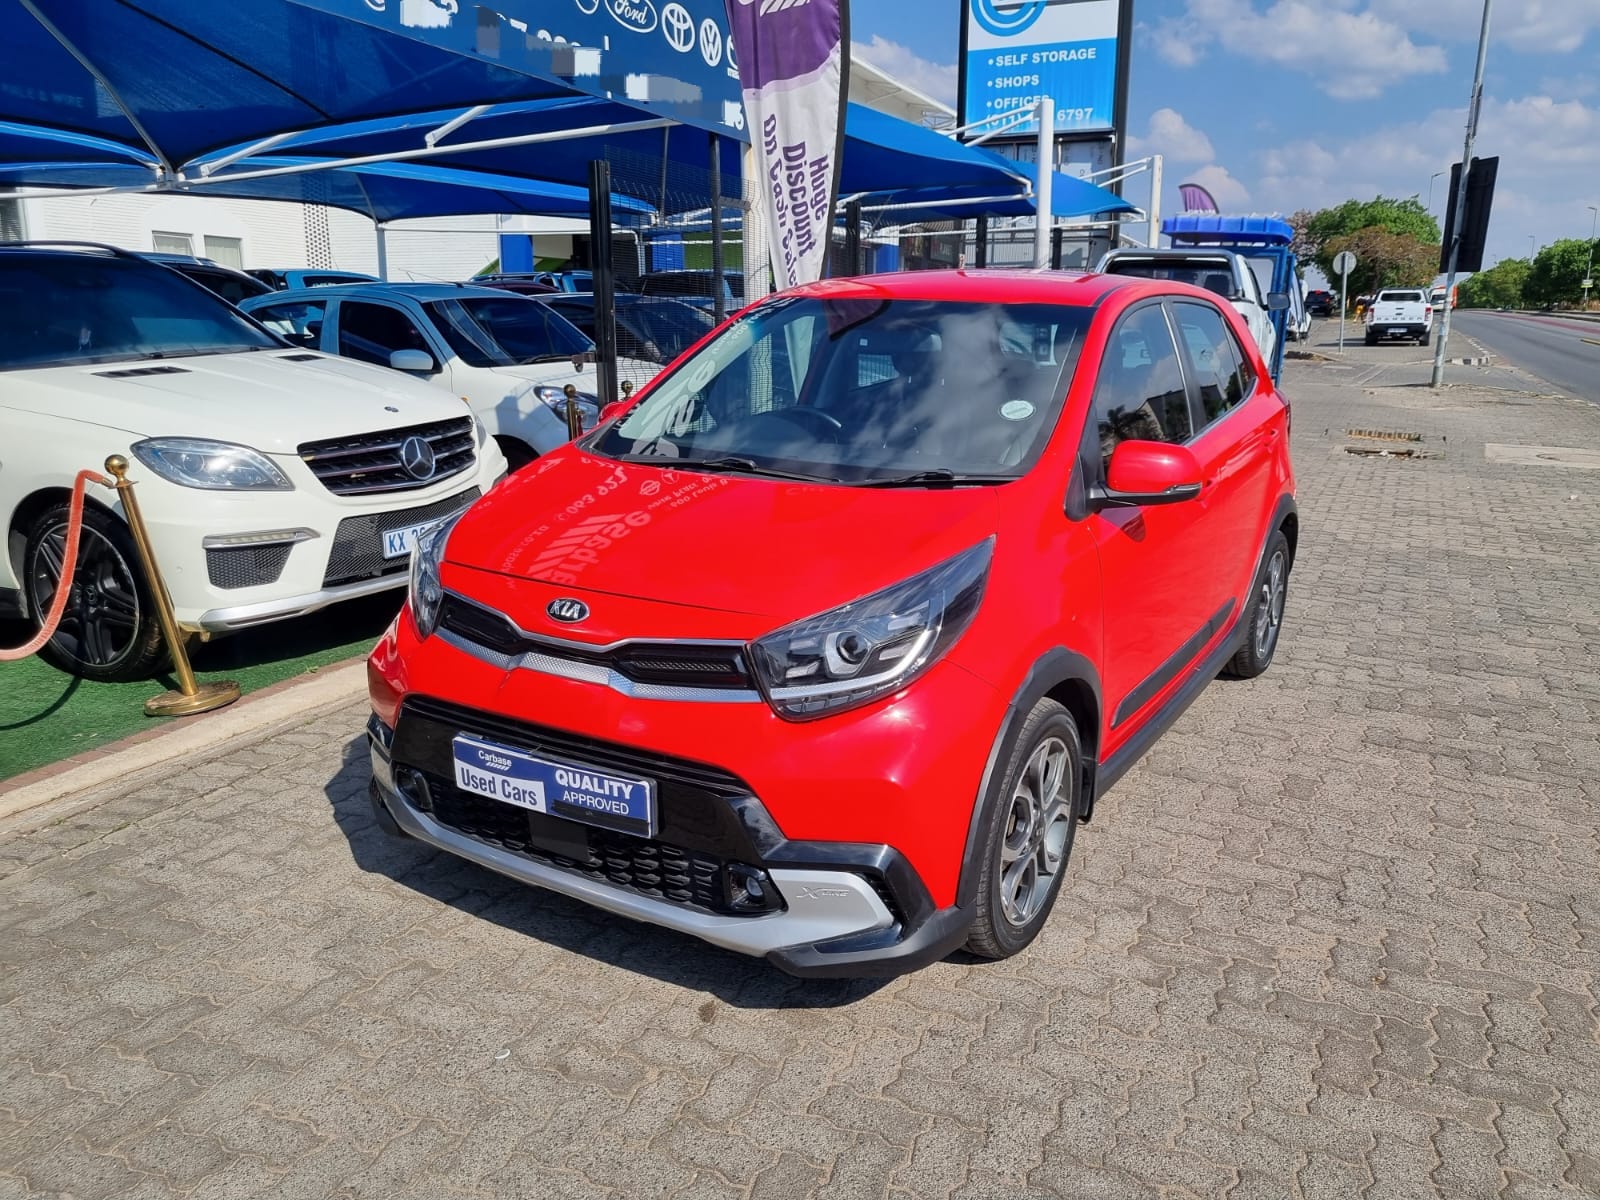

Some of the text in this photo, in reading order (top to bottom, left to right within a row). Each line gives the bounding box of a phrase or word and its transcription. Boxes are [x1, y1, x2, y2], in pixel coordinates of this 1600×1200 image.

[995, 47, 1097, 67] SELF STORAGE
[995, 75, 1040, 88] SHOPS
[1057, 108, 1093, 121] 6797
[809, 154, 829, 221] Huge
[782, 141, 817, 257] Discount
[388, 532, 406, 554] KX
[550, 600, 580, 619] KIA
[478, 749, 512, 767] Carbase
[460, 767, 538, 806] Used Cars
[555, 769, 634, 800] QUALITY
[563, 790, 630, 816] APPROVED
